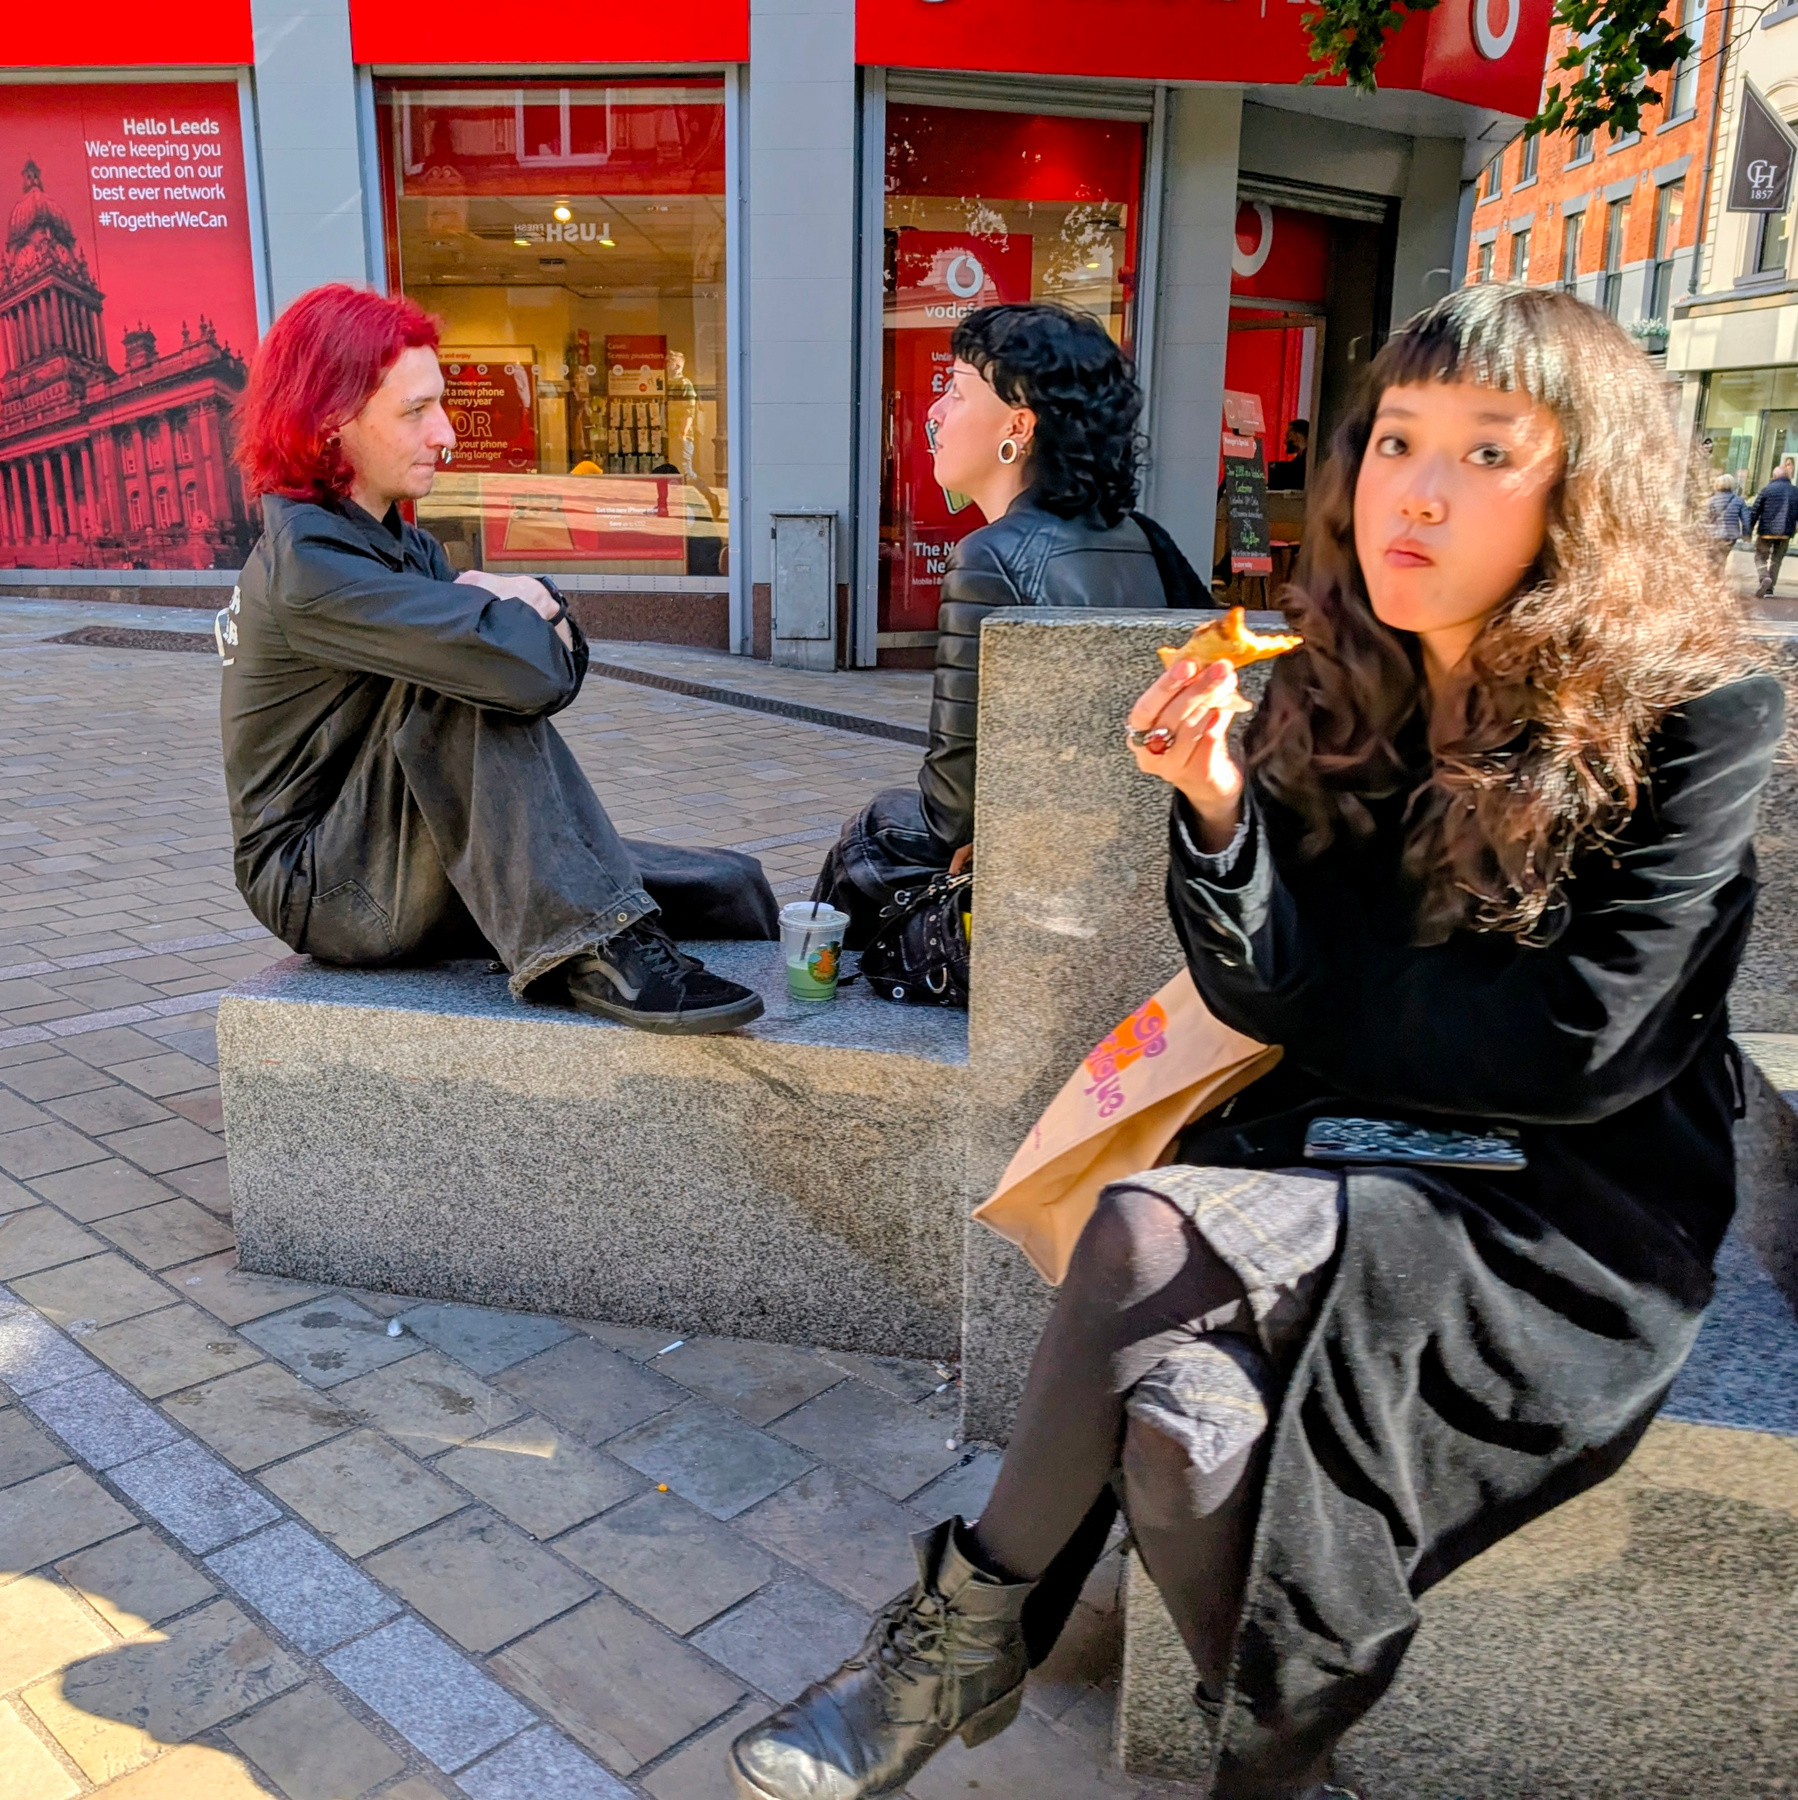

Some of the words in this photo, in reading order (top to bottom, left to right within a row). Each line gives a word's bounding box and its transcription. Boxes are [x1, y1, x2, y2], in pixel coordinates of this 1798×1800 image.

[123, 118, 167, 135] Hello
[170, 118, 220, 135] Leeds
[85, 140, 126, 157] We're
[129, 140, 190, 160] keeping
[192, 143, 221, 160] you
[91, 162, 171, 179] connected
[174, 165, 194, 178] on
[198, 164, 223, 178] our
[92, 184, 125, 200] best
[128, 186, 160, 200] ever
[163, 183, 225, 200] network
[1751, 189, 1774, 200] 1857
[99, 211, 228, 231] #TogetherWeCan
[458, 389, 476, 397] new
[477, 387, 505, 399] phone
[448, 398, 472, 408] every
[473, 398, 493, 408] year
[451, 410, 492, 437] OR
[459, 441, 479, 451] your
[480, 440, 508, 451] phone
[452, 450, 473, 461] sting
[473, 450, 502, 461] longer
[913, 541, 940, 557] The
[912, 577, 932, 585] Mobile
